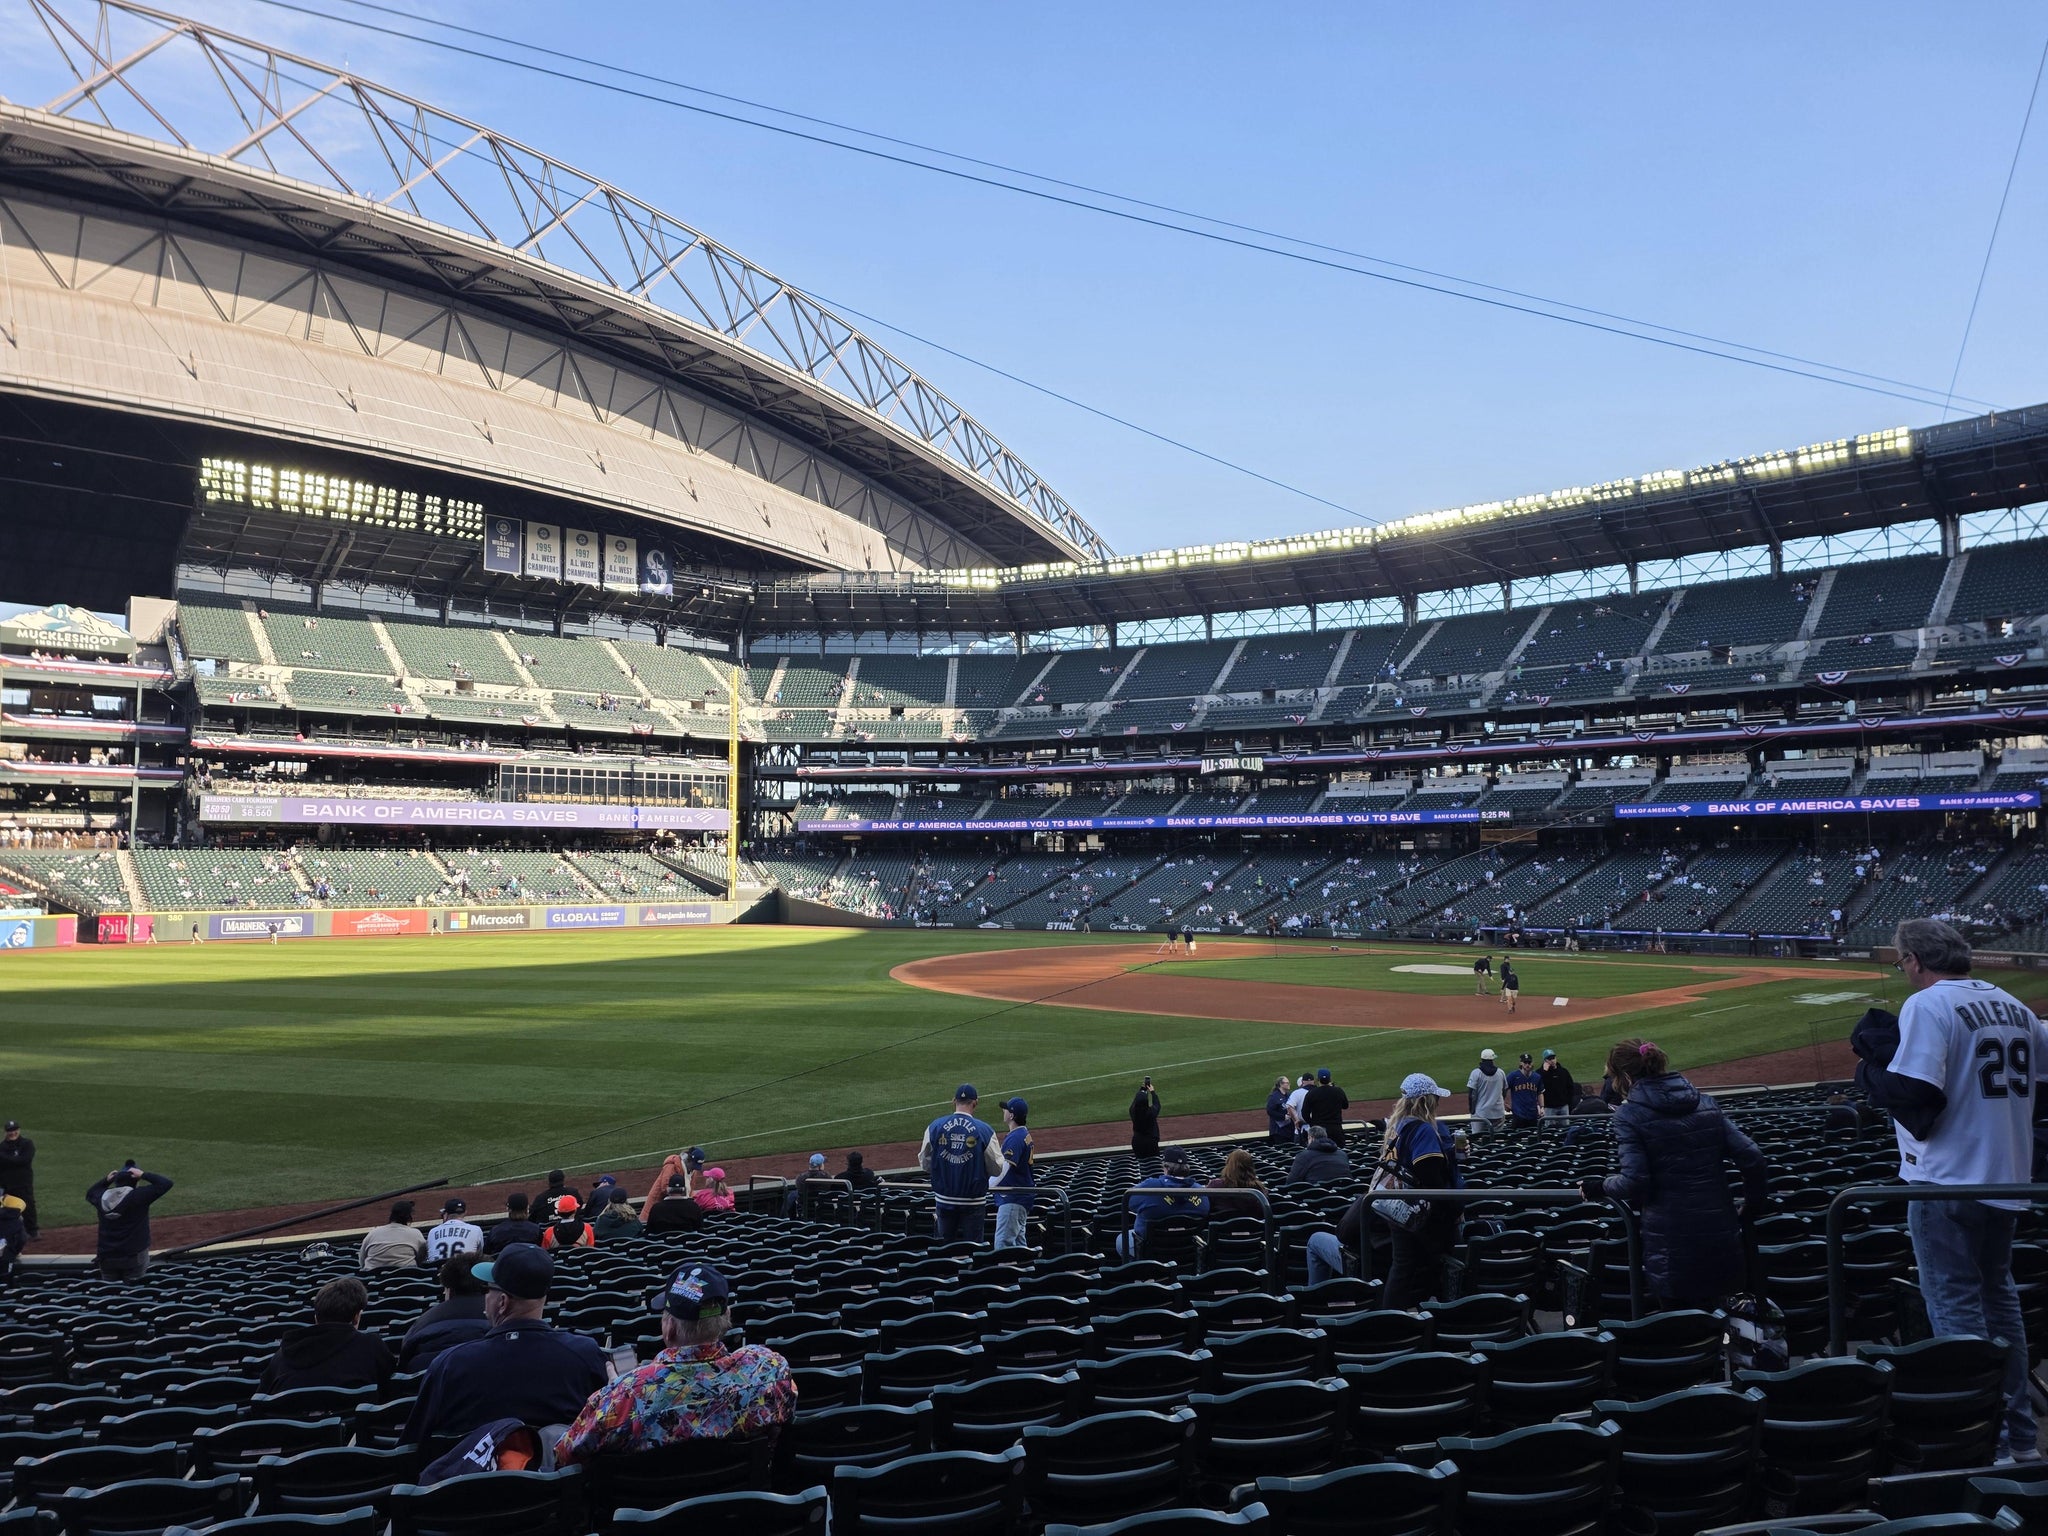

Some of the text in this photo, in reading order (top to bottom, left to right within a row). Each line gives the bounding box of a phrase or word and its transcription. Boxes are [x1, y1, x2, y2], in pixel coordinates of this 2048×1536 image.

[536, 542, 552, 552] 1995
[576, 549, 590, 558] 1997
[614, 554, 628, 564] 2001
[528, 563, 558, 573] CHAMPIONS
[580, 560, 594, 569] WEST
[567, 568, 597, 579] CHAMPIONS
[619, 567, 632, 575] WEST
[606, 574, 635, 584] CHAMPIONS
[16, 629, 118, 646] MUCKLESHOOT
[73, 642, 100, 650] TRIBE
[1241, 757, 1264, 772] CLUB
[1976, 796, 2014, 804] AMERICA
[1708, 798, 1920, 813] BANK OF AMERICA SAVES
[302, 804, 578, 822] BANK OF AMERICA SAVES
[599, 813, 693, 823] BANK OF AMERICA
[1030, 820, 1050, 828] YOU
[1266, 816, 1342, 824] ENCOURAGES
[1372, 814, 1388, 822] TO
[470, 913, 524, 926] Microsoft
[552, 912, 599, 922] GLOBAL
[656, 912, 685, 920] Benjamin
[1046, 922, 1076, 931] STIHL
[1130, 924, 1147, 932] Clips
[1955, 1000, 2030, 1032] RALEIGH
[1976, 1038, 2030, 1099] 29
[943, 1118, 976, 1133] SEATTLE
[950, 1133, 965, 1141] SINCE
[940, 1149, 974, 1164] MARINERS
[434, 1227, 471, 1240] GILBERT
